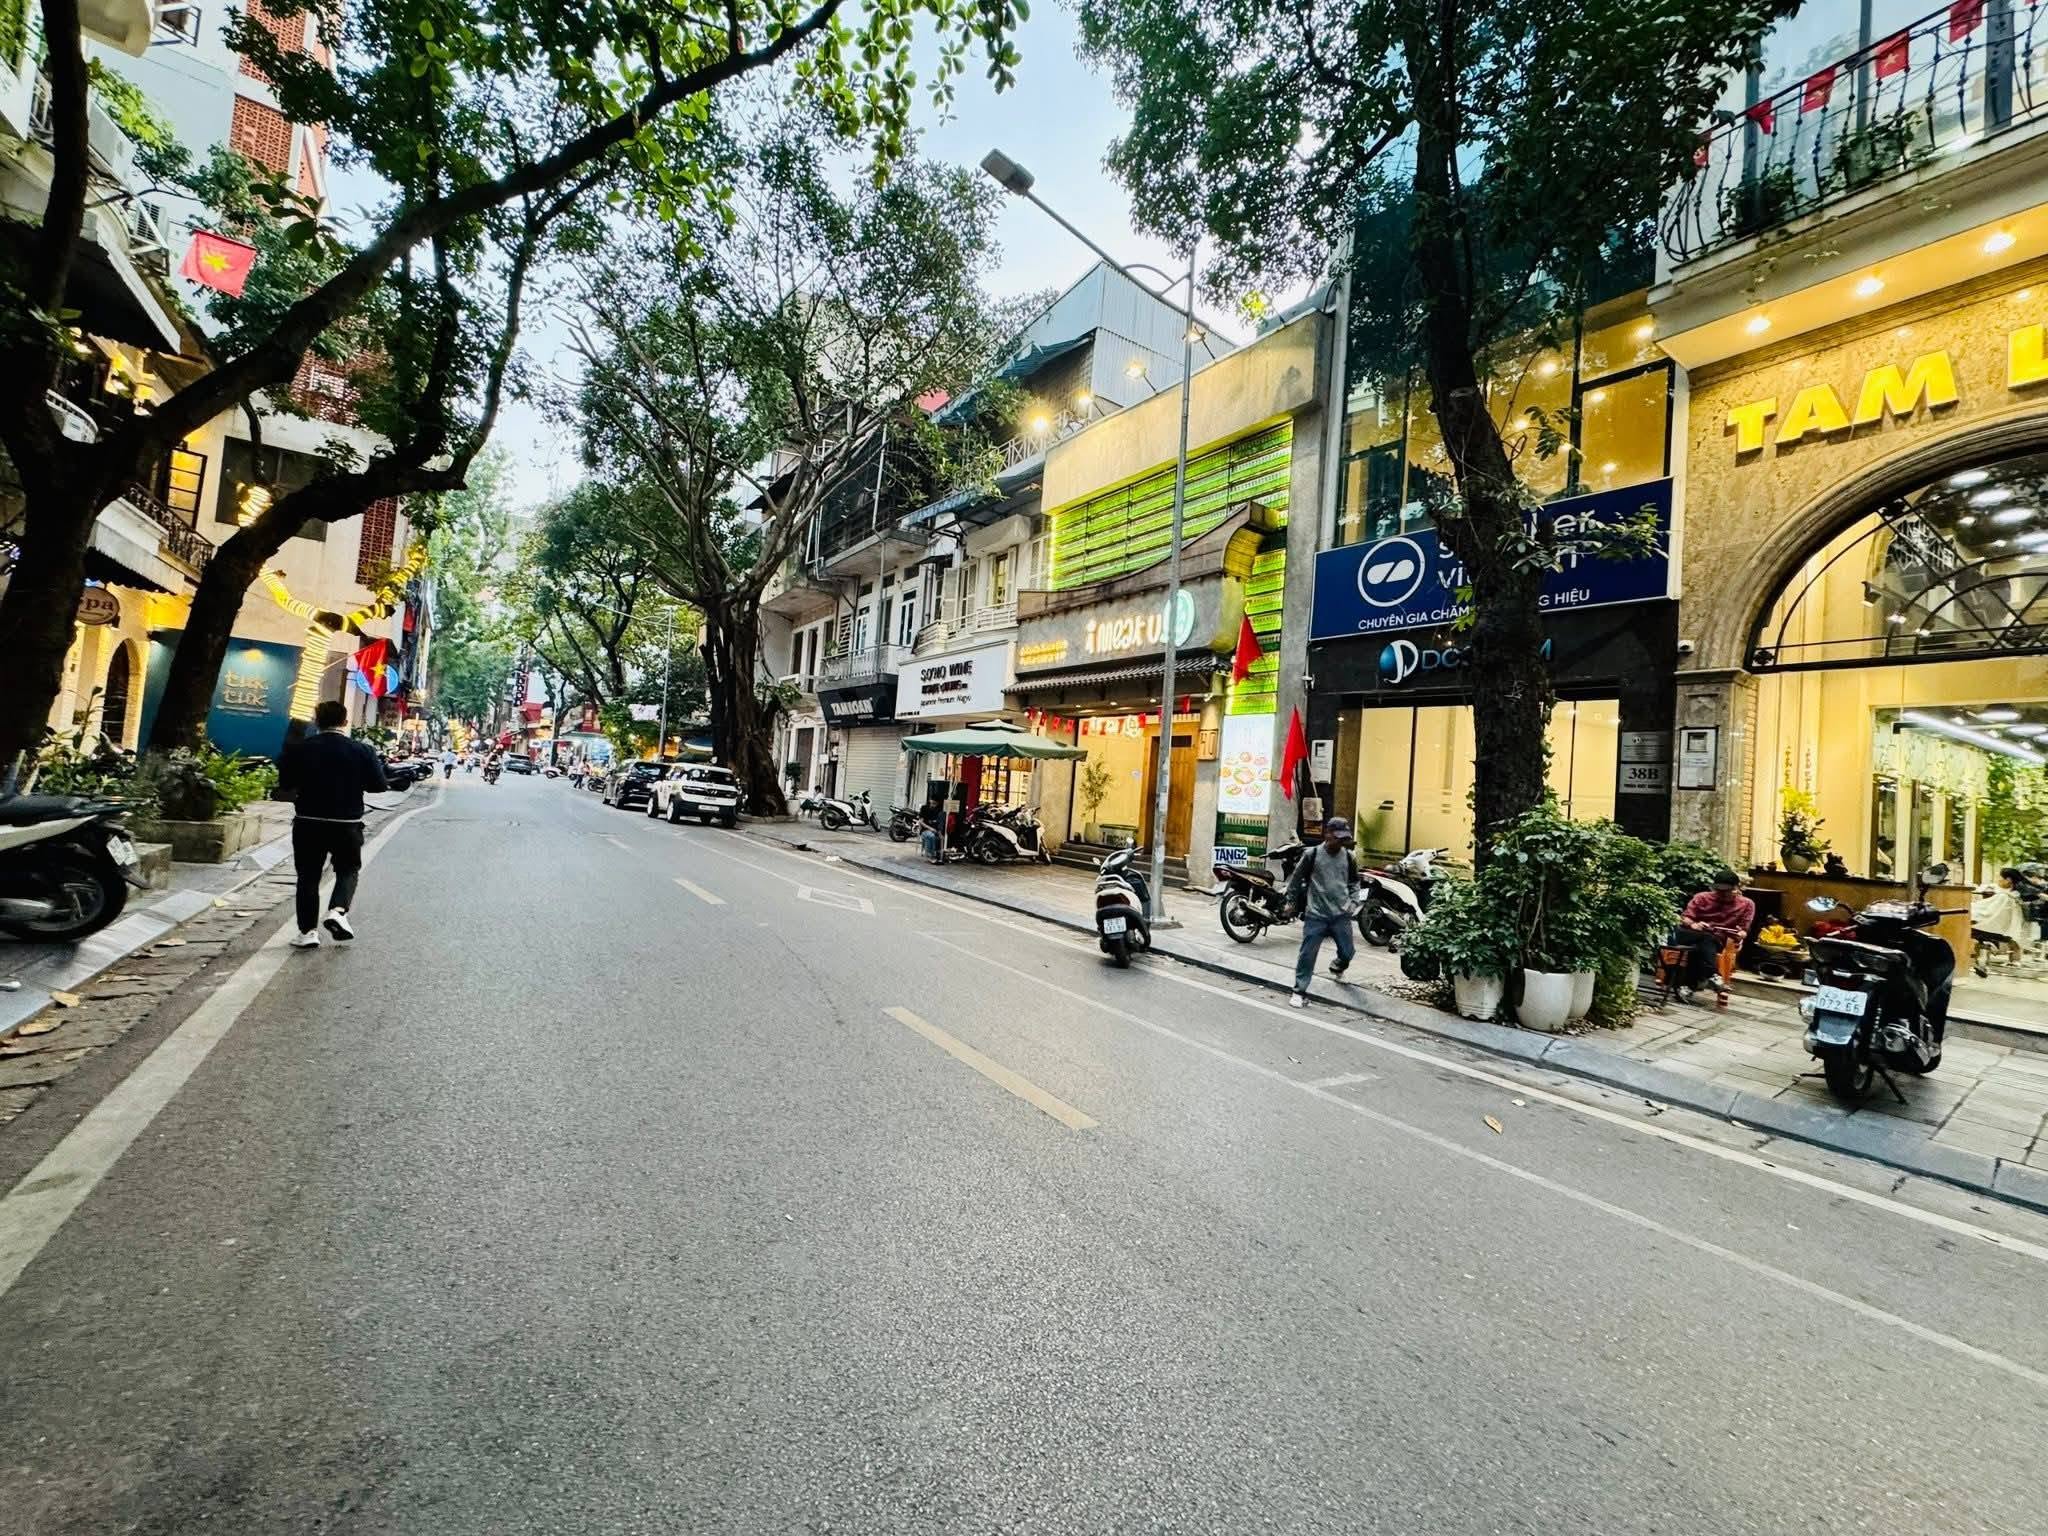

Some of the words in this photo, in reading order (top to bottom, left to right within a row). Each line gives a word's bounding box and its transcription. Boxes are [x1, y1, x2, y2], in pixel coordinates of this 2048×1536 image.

[1727, 349, 1959, 453] TAM
[1358, 613, 1404, 630] CHUYÊN
[1406, 611, 1428, 624] GIA
[1431, 605, 1470, 621] CHĂM
[1554, 587, 1590, 606] HIỆU
[1628, 767, 1659, 780] 38B
